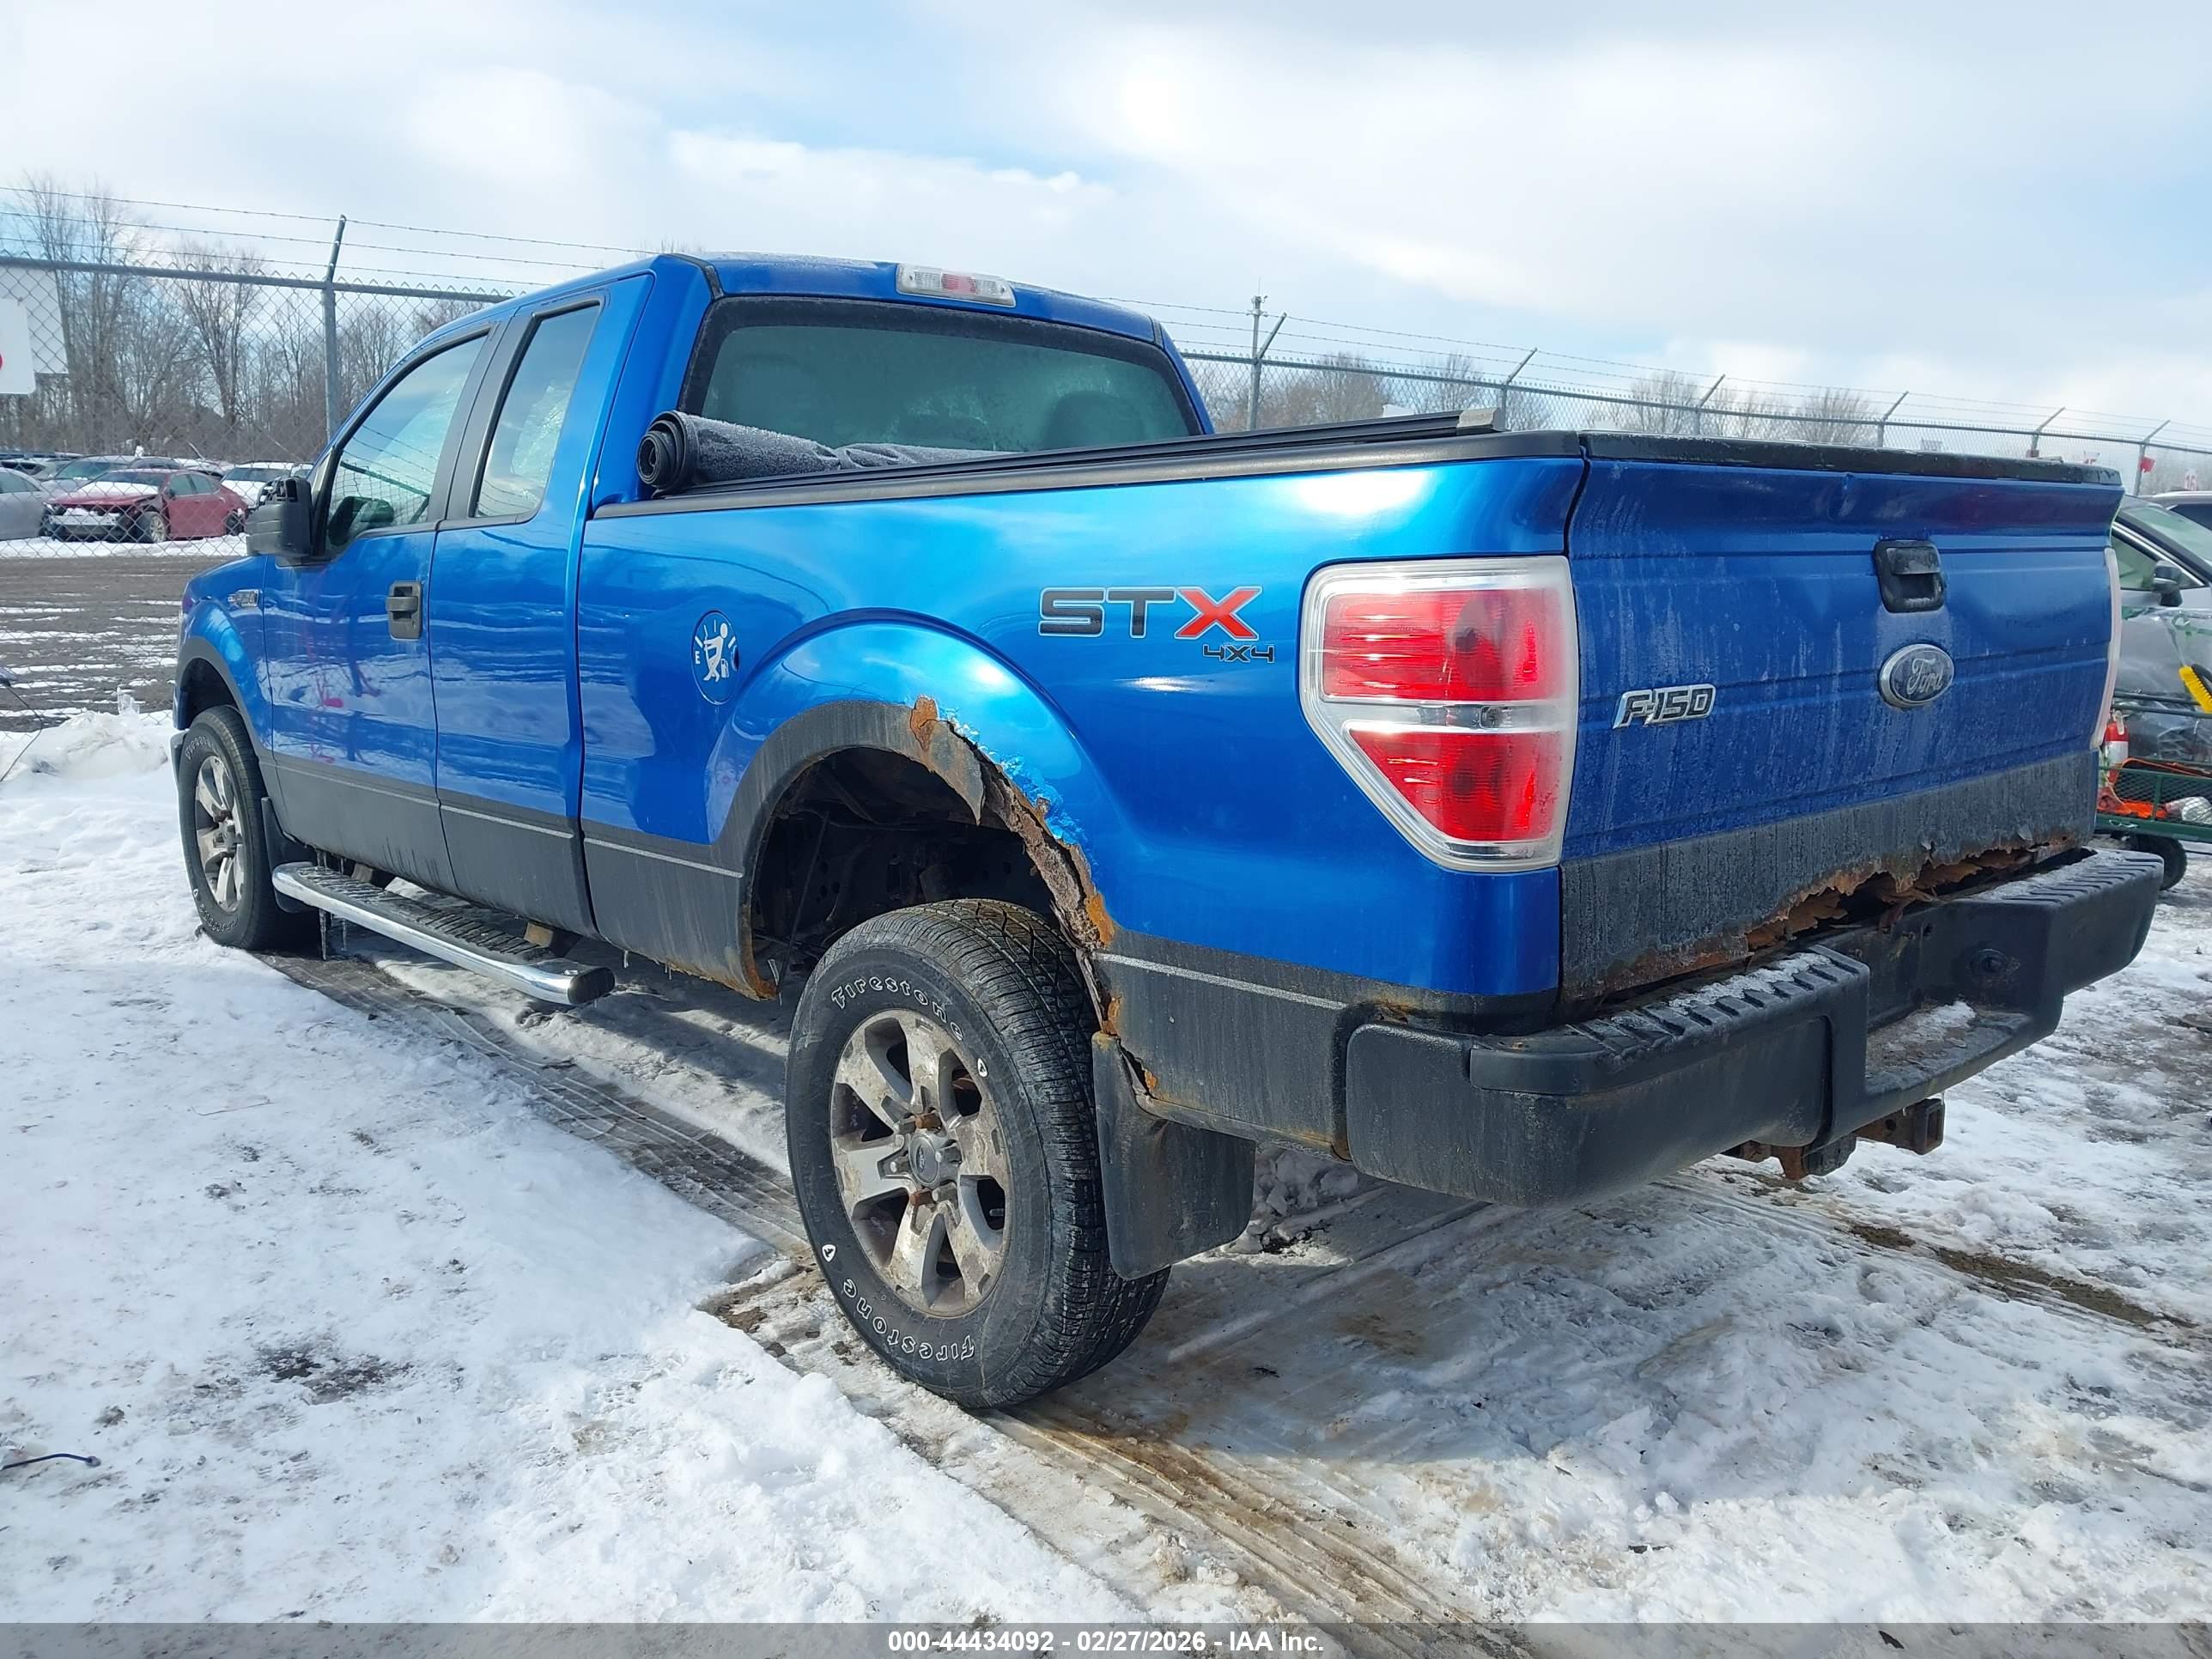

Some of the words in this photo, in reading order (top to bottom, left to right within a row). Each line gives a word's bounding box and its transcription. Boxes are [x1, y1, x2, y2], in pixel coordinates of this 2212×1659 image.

[1038, 586, 1263, 641] STX
[695, 651, 701, 665] E
[1907, 658, 1944, 695] Ford
[1613, 684, 1717, 729] F-150
[831, 975, 963, 1041] Firestone
[843, 1279, 975, 1361] Firestone
